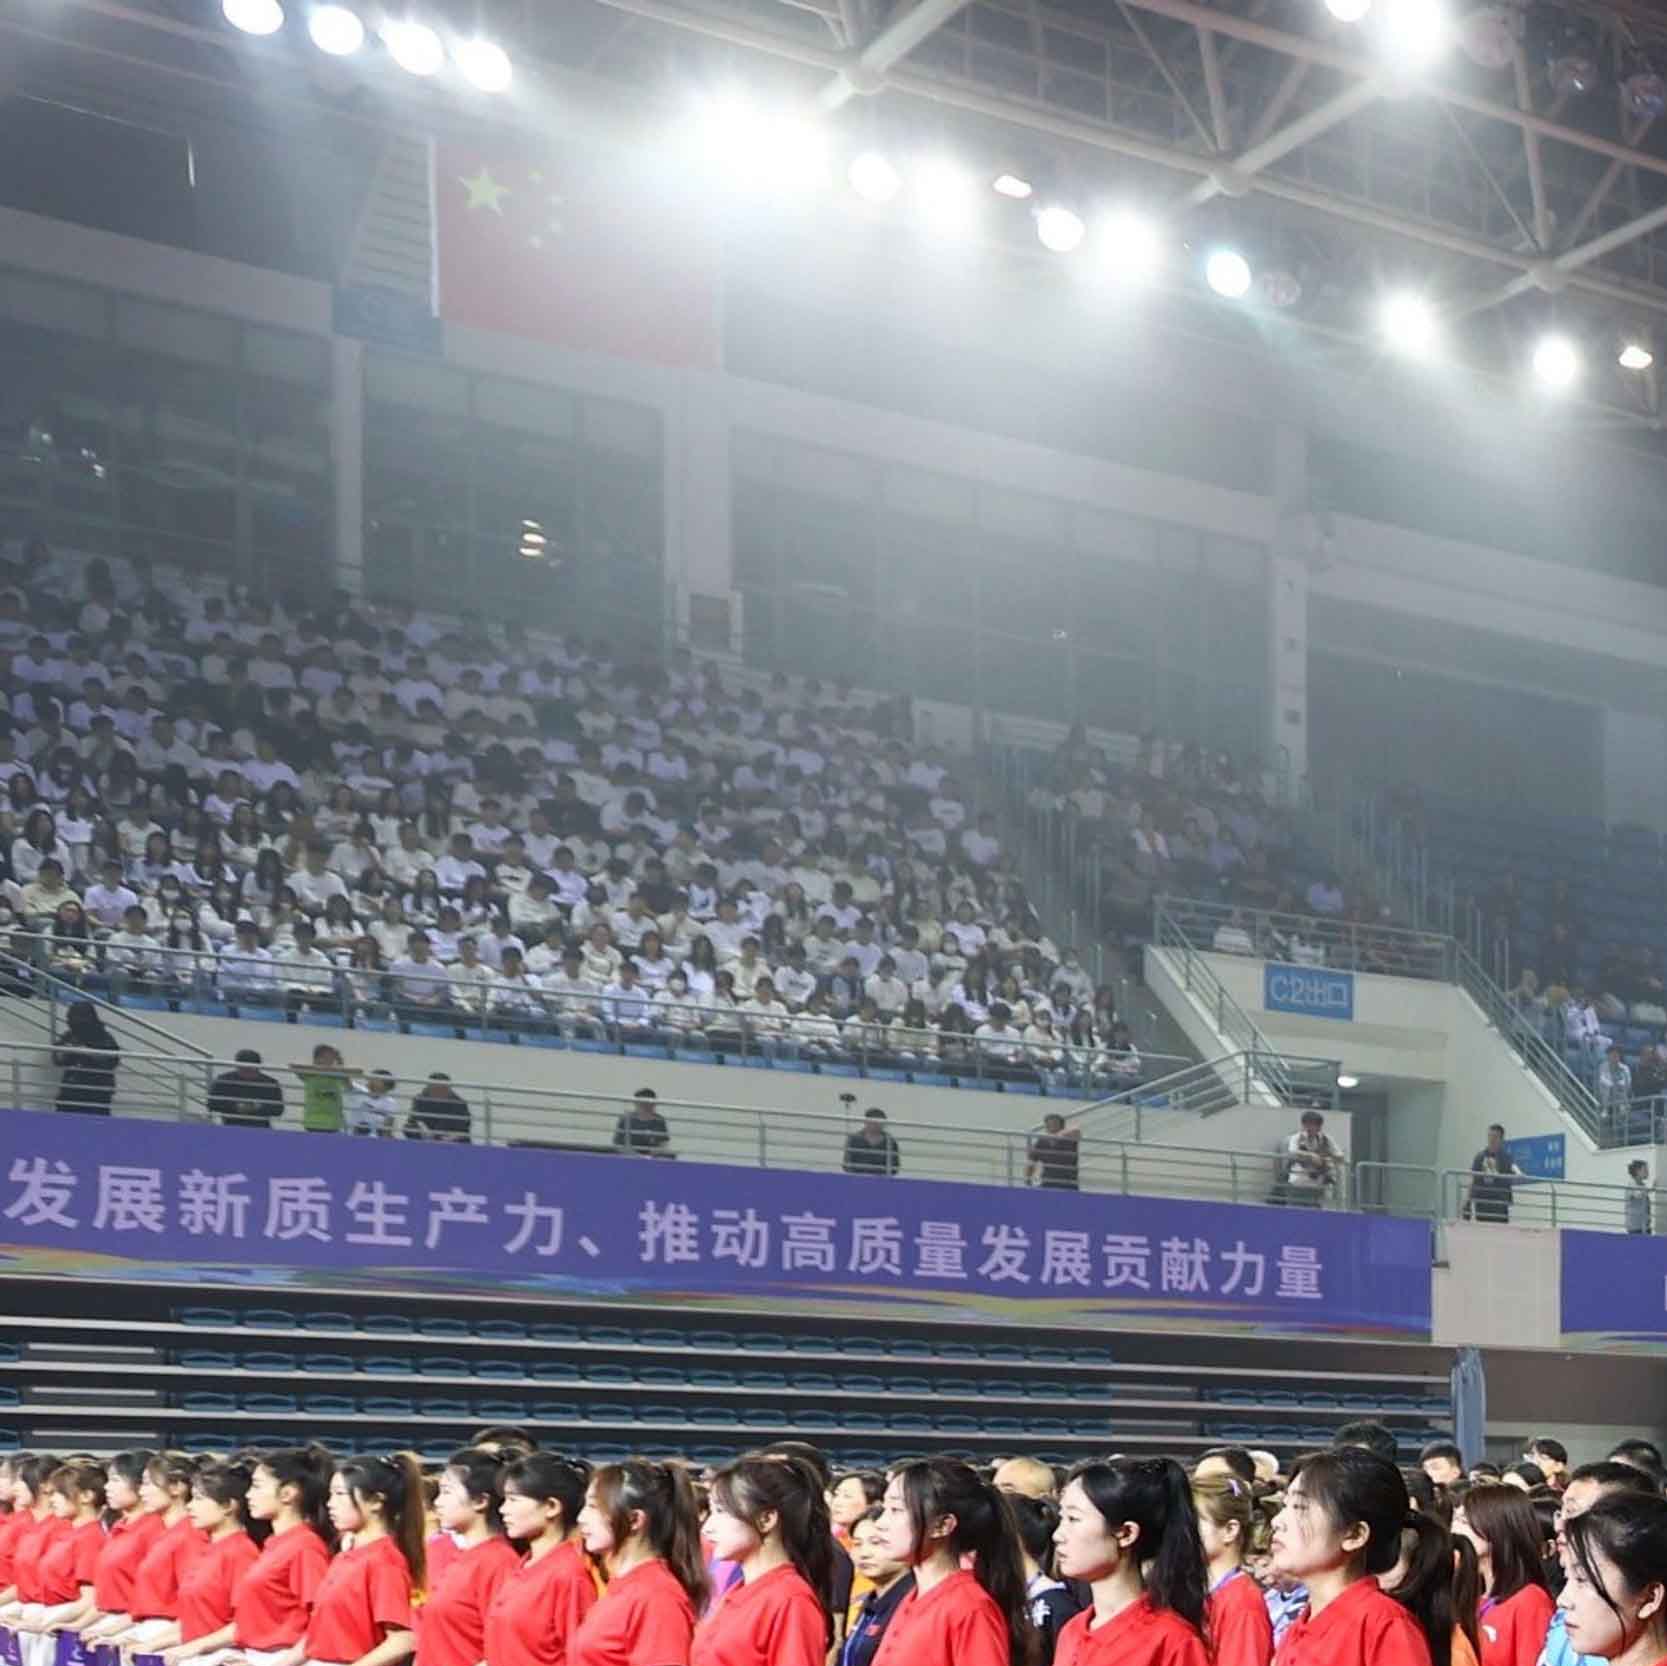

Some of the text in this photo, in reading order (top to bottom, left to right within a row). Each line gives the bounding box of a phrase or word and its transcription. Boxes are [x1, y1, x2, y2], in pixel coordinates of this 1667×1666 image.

[4, 1157, 1324, 1300] 发展新质生产力、推动高质量发展贡献力量
